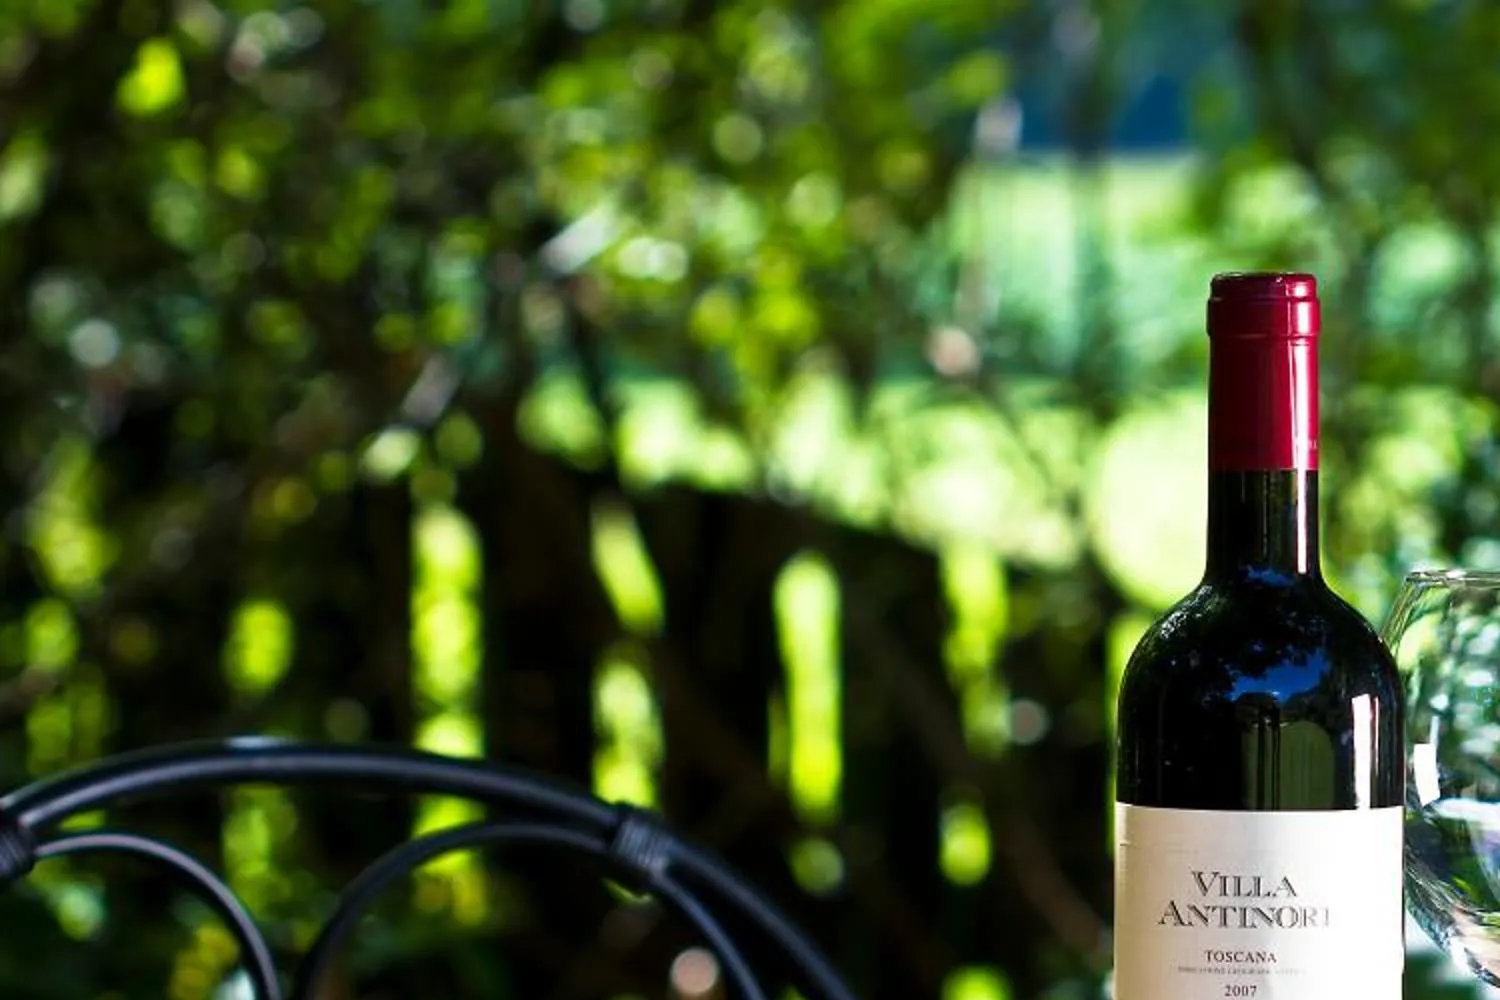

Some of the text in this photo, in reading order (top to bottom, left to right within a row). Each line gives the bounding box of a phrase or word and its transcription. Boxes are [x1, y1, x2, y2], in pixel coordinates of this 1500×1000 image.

[1191, 870, 1298, 898] VILLA
[1157, 900, 1331, 929] ANTINORI
[1203, 949, 1278, 964] TOSCANA
[1224, 984, 1257, 997] 2007
